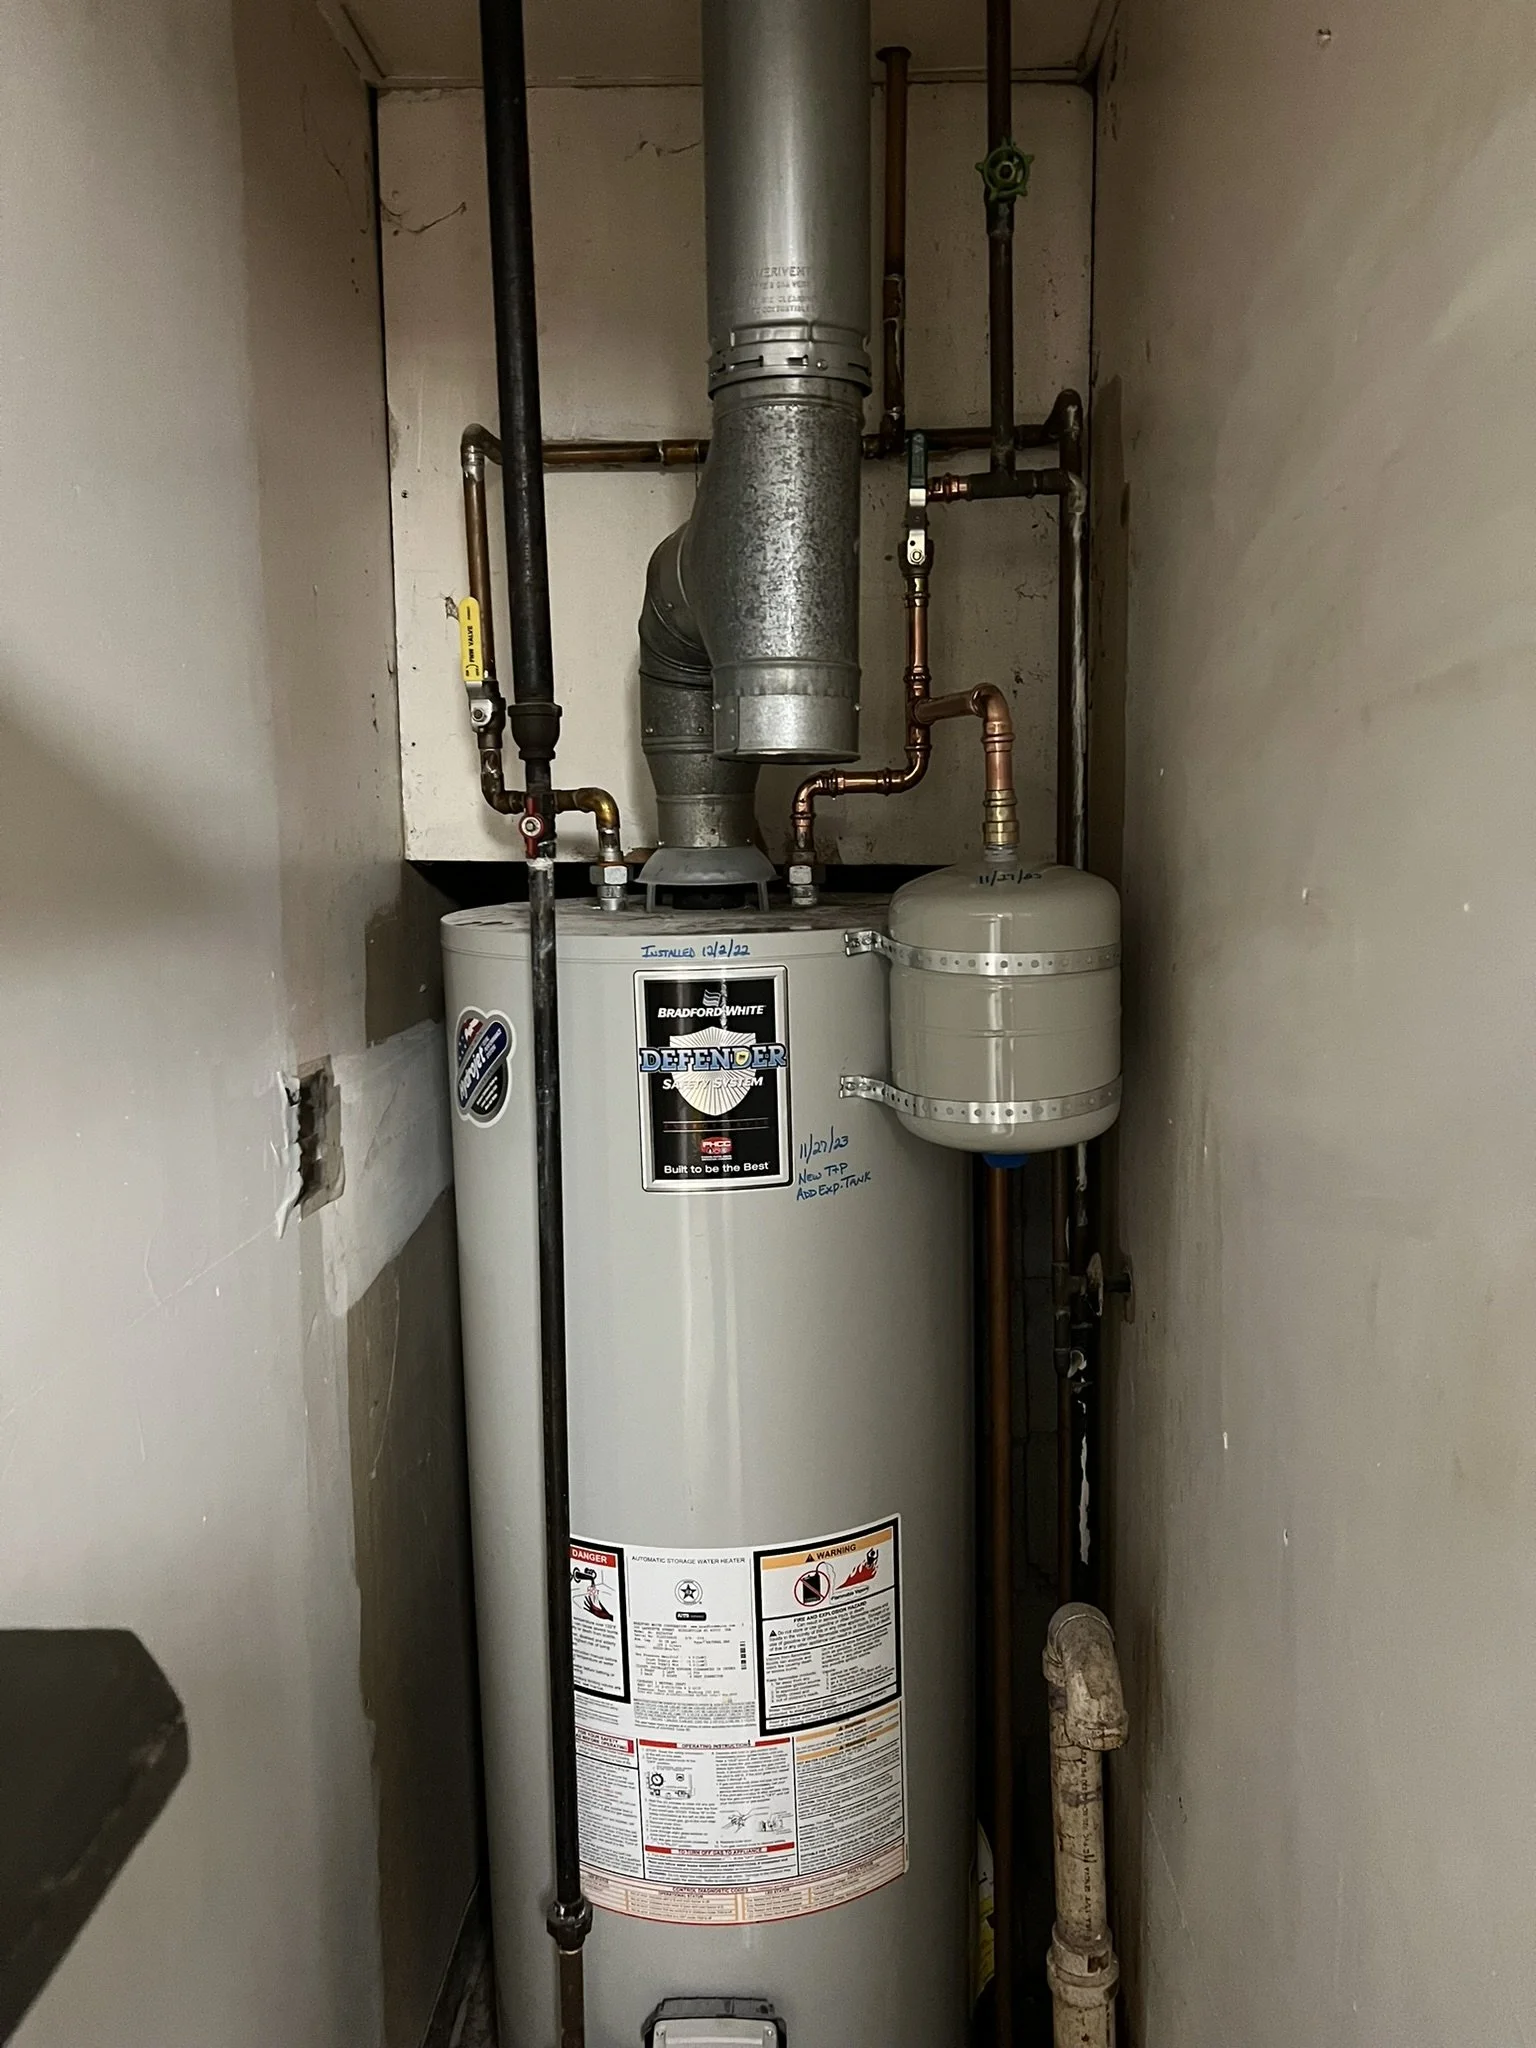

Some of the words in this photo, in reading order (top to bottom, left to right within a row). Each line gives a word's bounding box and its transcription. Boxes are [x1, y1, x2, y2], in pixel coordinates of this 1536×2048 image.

[641, 945, 696, 958] INSTALLED
[701, 939, 751, 958] 12/2/22
[640, 1045, 787, 1072] DEFENDER
[662, 1079, 711, 1090] SAFETY
[713, 1076, 764, 1089] SYSTEM
[799, 1125, 849, 1163] 11/27/23
[664, 1164, 688, 1174] Built
[690, 1165, 702, 1174] to
[705, 1164, 719, 1173] be
[722, 1163, 740, 1173] the
[744, 1161, 769, 1171] Best
[571, 1549, 607, 1564] DANGER
[816, 1543, 857, 1560] WARNING
[631, 1556, 665, 1564] AUTOMATIC
